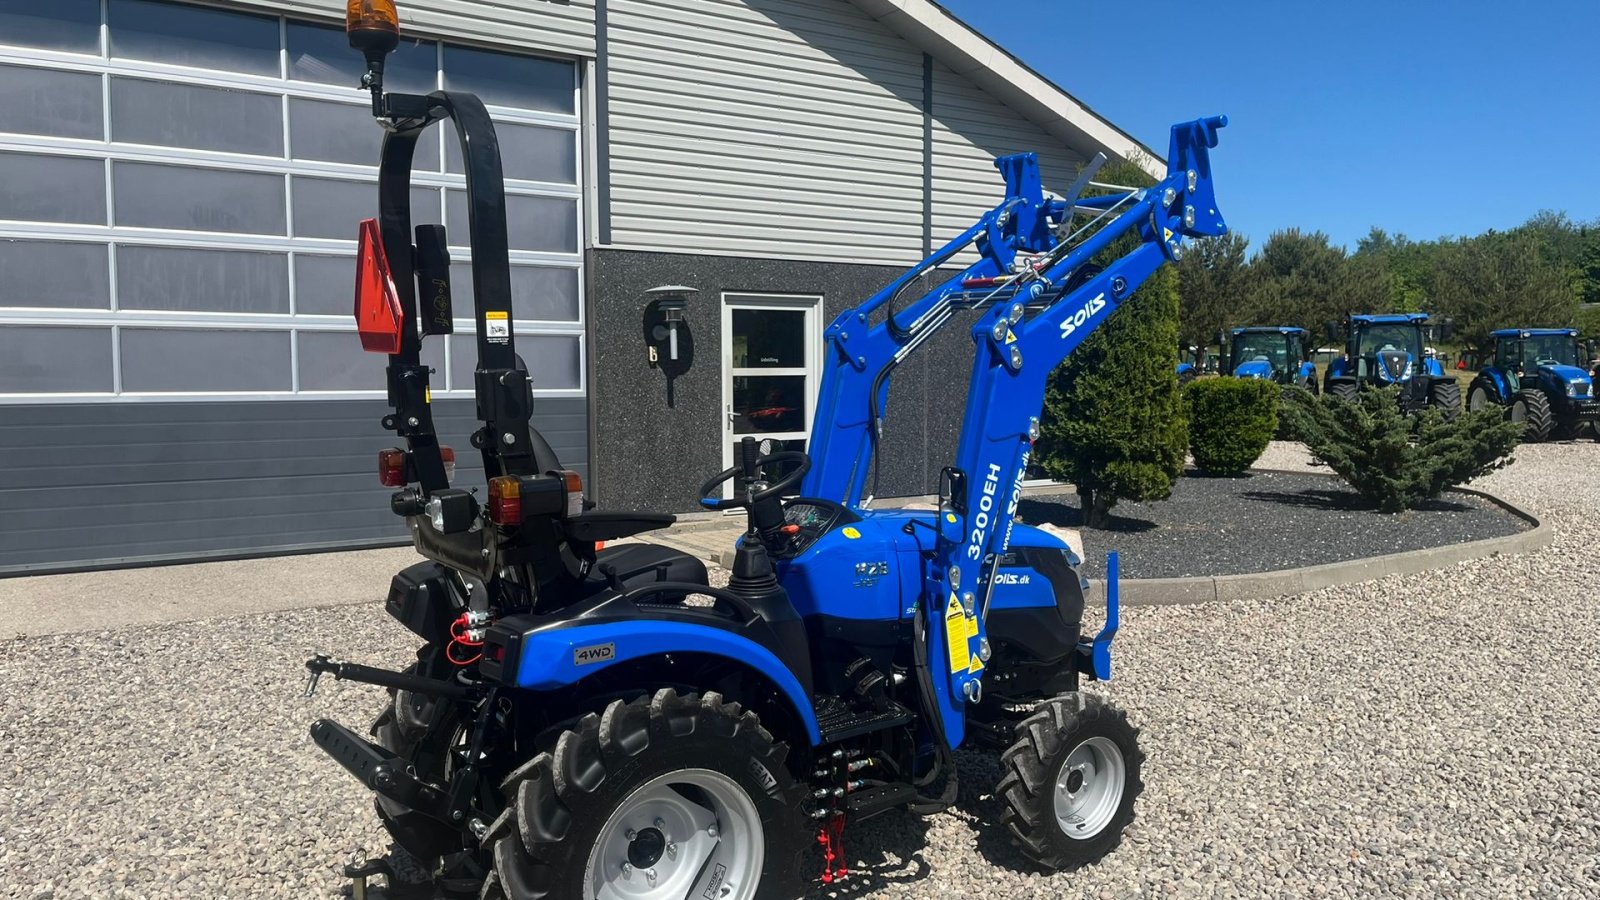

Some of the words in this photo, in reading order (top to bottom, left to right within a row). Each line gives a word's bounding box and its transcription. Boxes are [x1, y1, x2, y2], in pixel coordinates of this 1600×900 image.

[649, 345, 658, 362] 6
[967, 463, 1001, 561] 3200EH
[578, 647, 612, 660] 4WD
